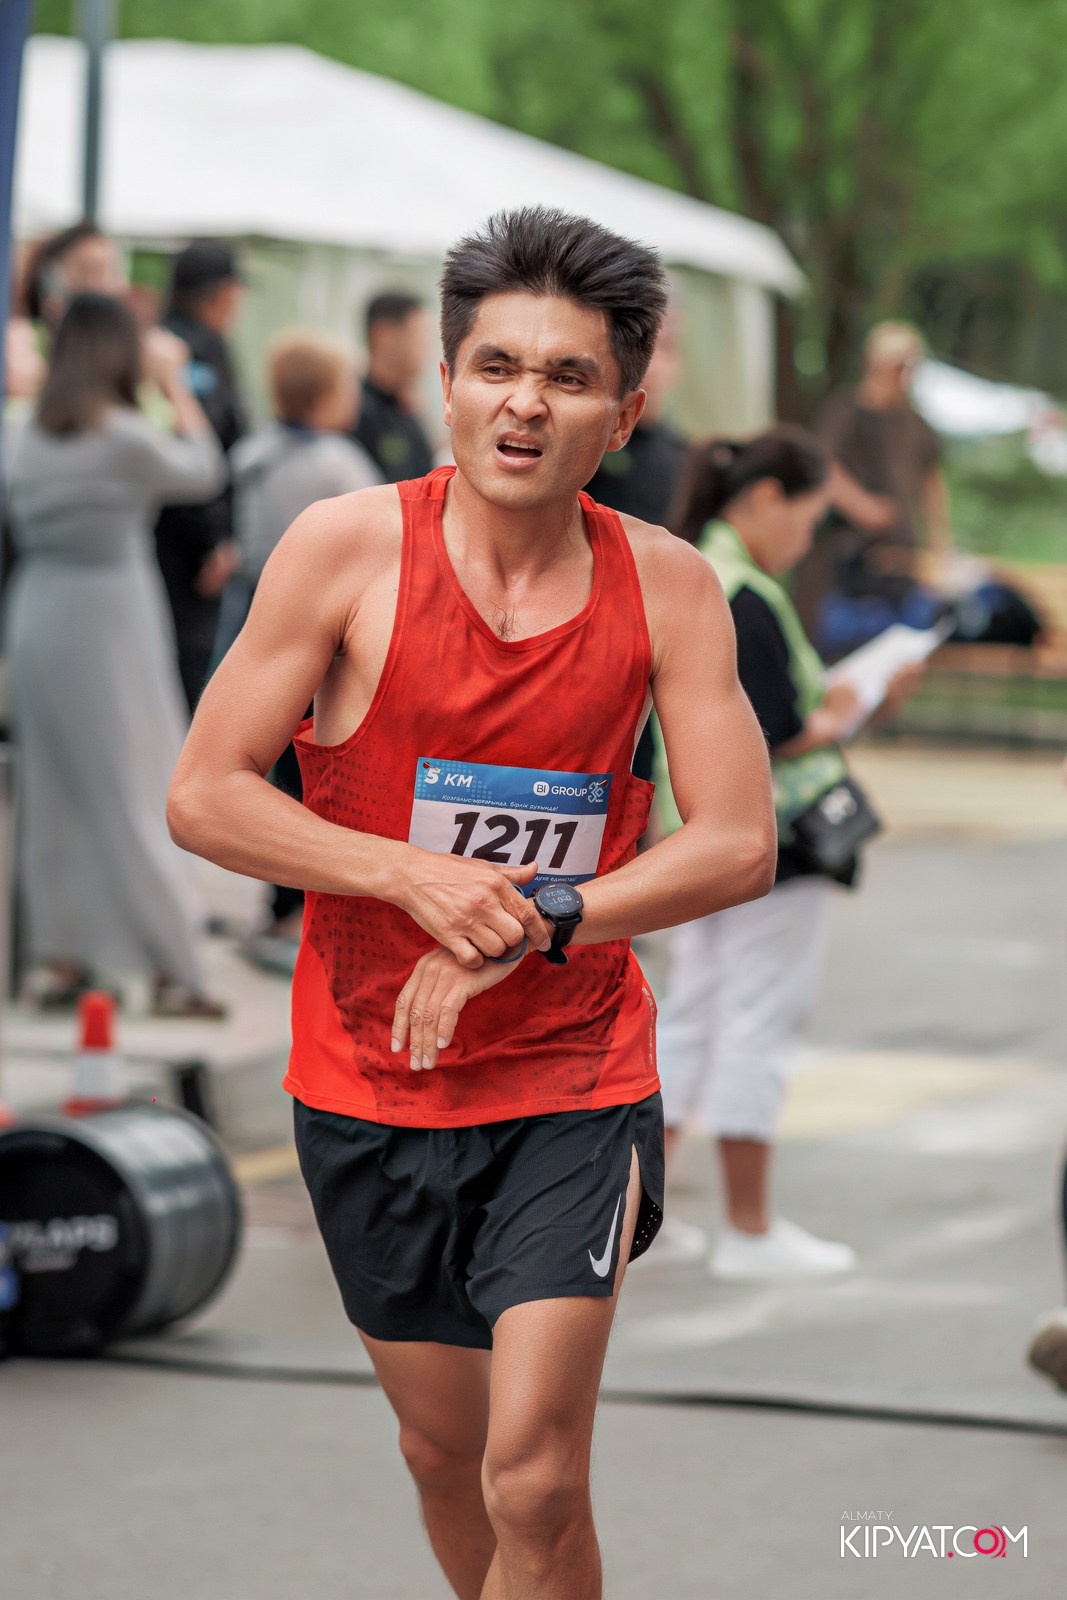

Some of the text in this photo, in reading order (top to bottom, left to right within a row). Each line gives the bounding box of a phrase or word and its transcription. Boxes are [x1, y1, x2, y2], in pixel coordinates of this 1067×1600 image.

[424, 768, 474, 788] 5 KM
[551, 785, 588, 797] GROUP
[451, 811, 578, 869] 1211
